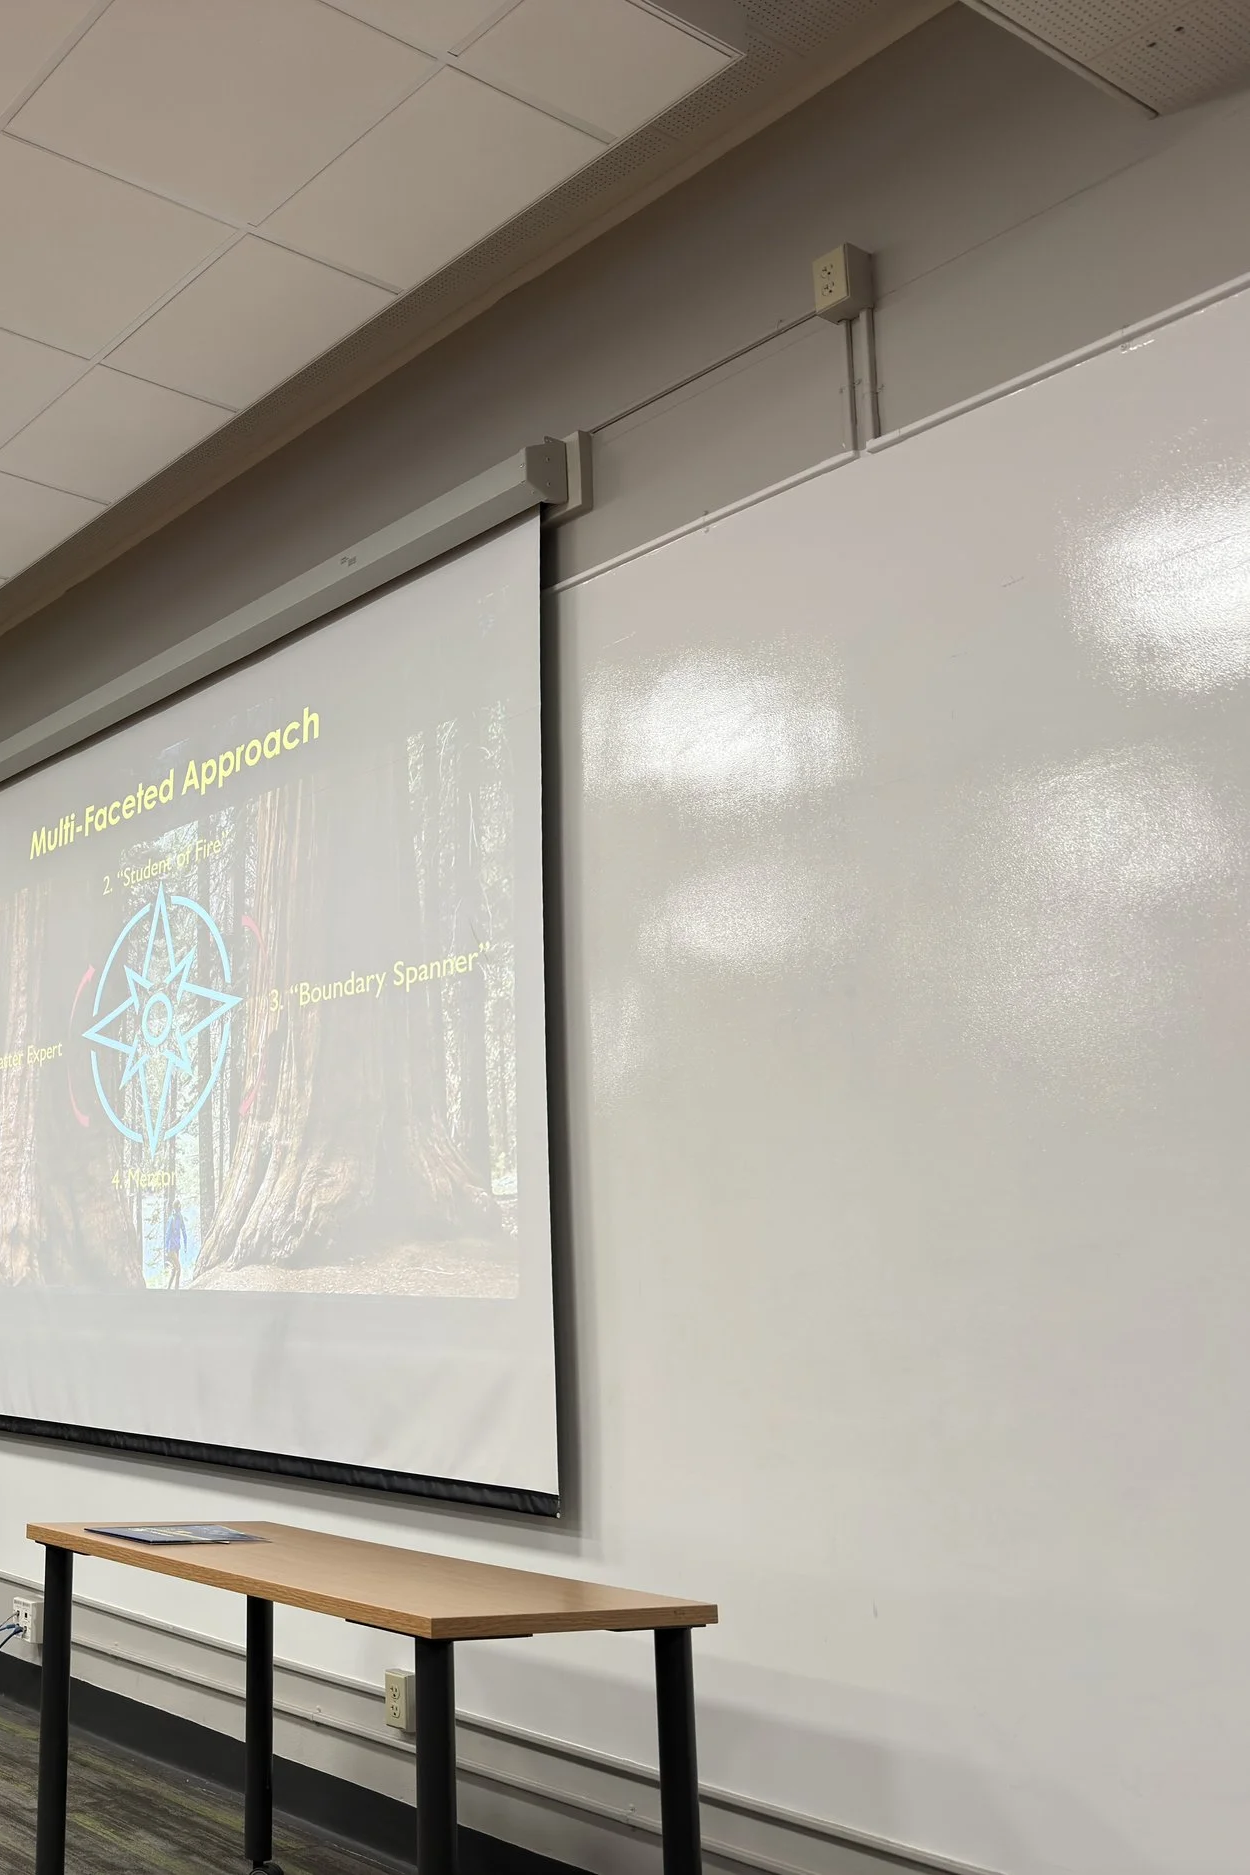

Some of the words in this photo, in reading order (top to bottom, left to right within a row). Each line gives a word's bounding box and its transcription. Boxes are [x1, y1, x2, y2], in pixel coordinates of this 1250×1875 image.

[30, 768, 174, 860] Multi-Faceted
[182, 706, 320, 795] Approach
[103, 875, 113, 896] 2.
[177, 844, 191, 867] of
[269, 988, 284, 1012] 3.
[27, 1042, 62, 1067] Expert
[111, 1169, 123, 1190] 4.
